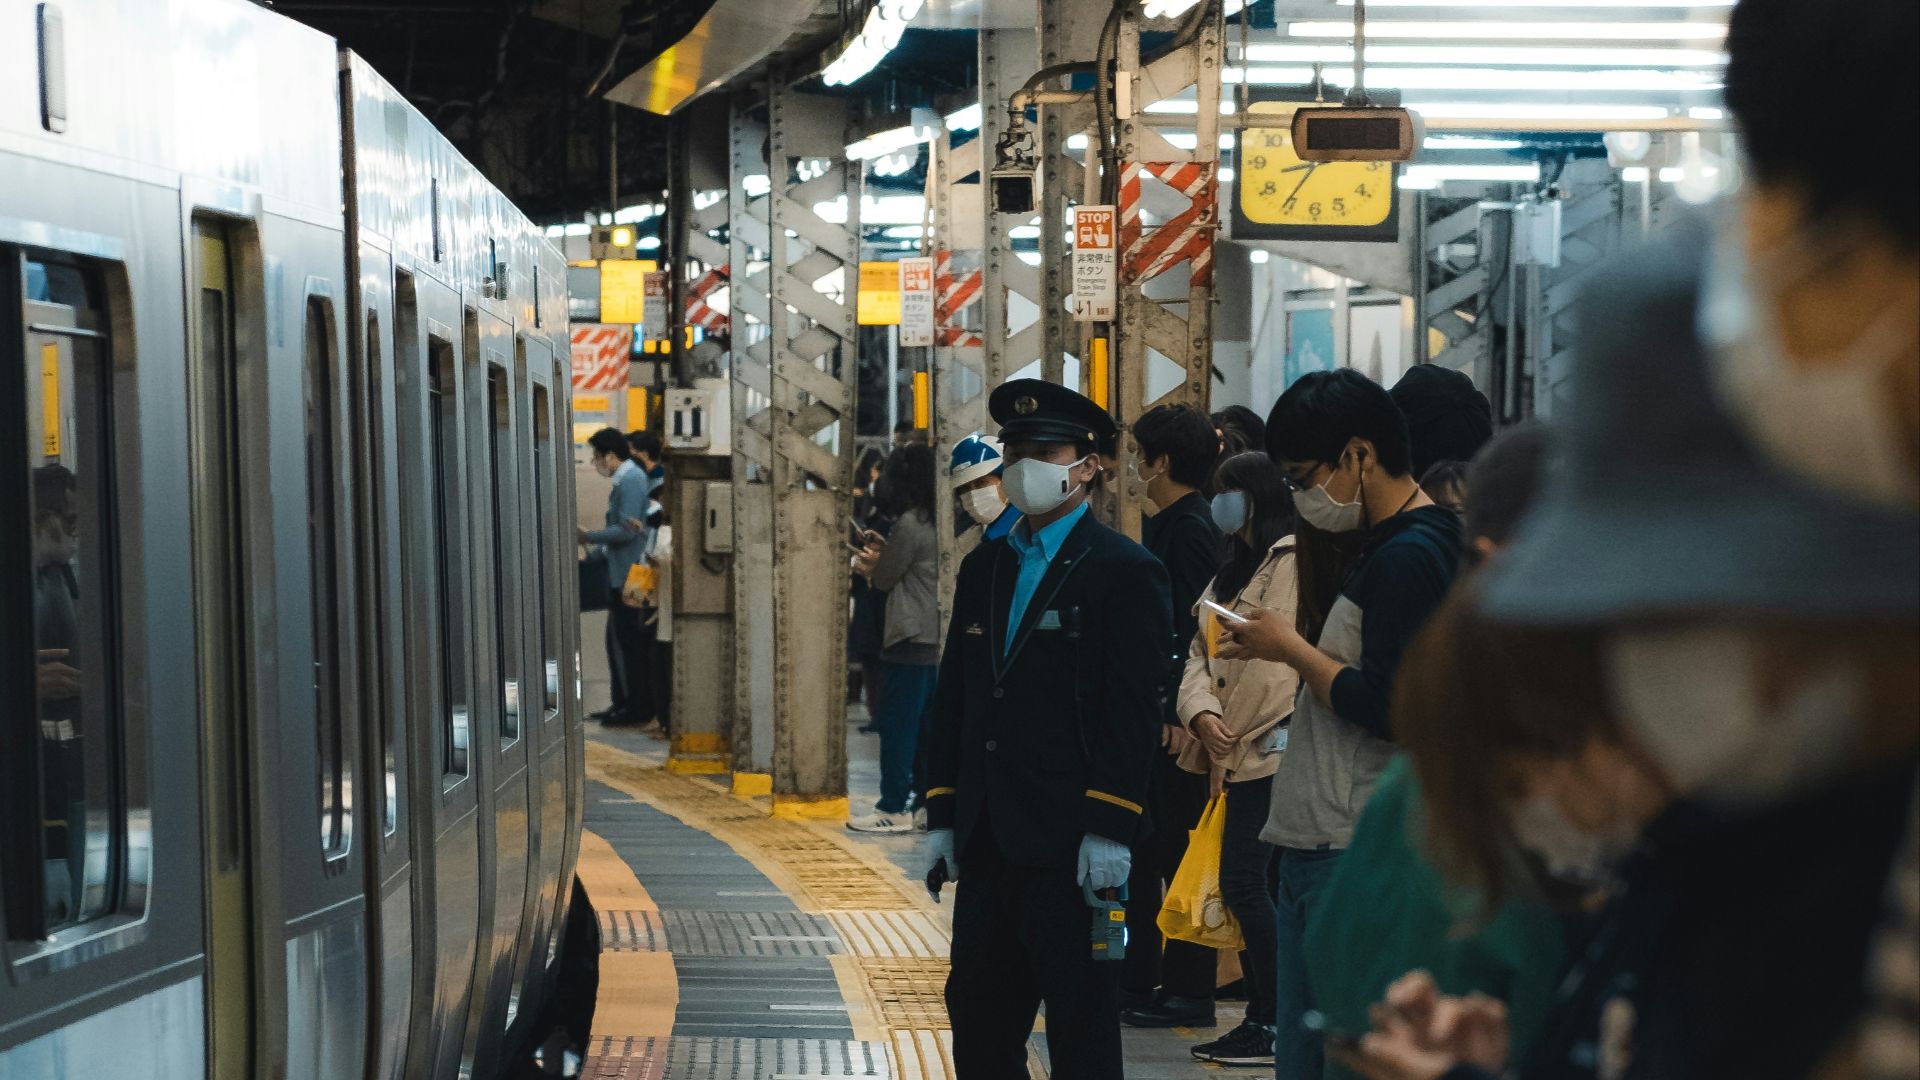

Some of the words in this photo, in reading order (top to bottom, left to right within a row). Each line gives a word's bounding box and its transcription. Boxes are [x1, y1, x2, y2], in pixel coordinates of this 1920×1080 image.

[1264, 134, 1283, 148] 10
[1254, 155, 1267, 169] 9
[1366, 161, 1378, 172] 3
[1264, 181, 1277, 195] 8
[1354, 183, 1367, 197] 4
[1308, 202, 1321, 215] 6
[1332, 198, 1345, 211] 5
[1078, 212, 1111, 224] STOP
[1077, 253, 1113, 264] 非常停止
[904, 262, 930, 273] STOP
[1077, 265, 1104, 276] ボタン
